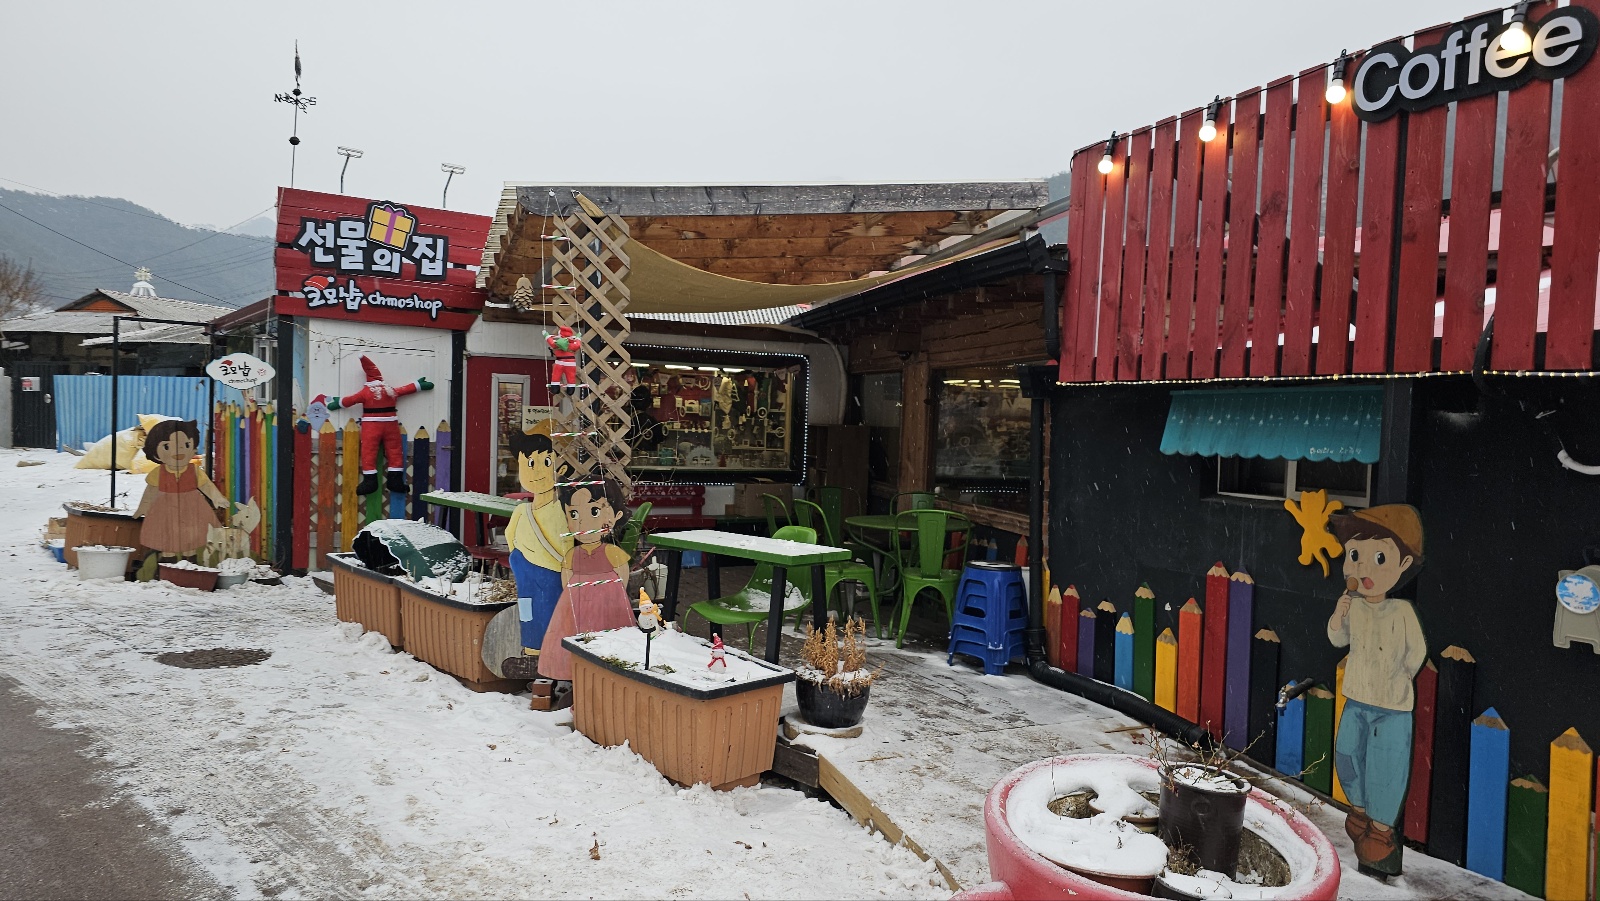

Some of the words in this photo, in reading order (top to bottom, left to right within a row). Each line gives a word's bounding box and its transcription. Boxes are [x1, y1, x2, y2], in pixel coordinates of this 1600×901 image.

[1353, 15, 1583, 112] Coffee
[297, 220, 401, 274] 선물의
[411, 235, 445, 277] 집
[367, 290, 443, 319] chmoshop
